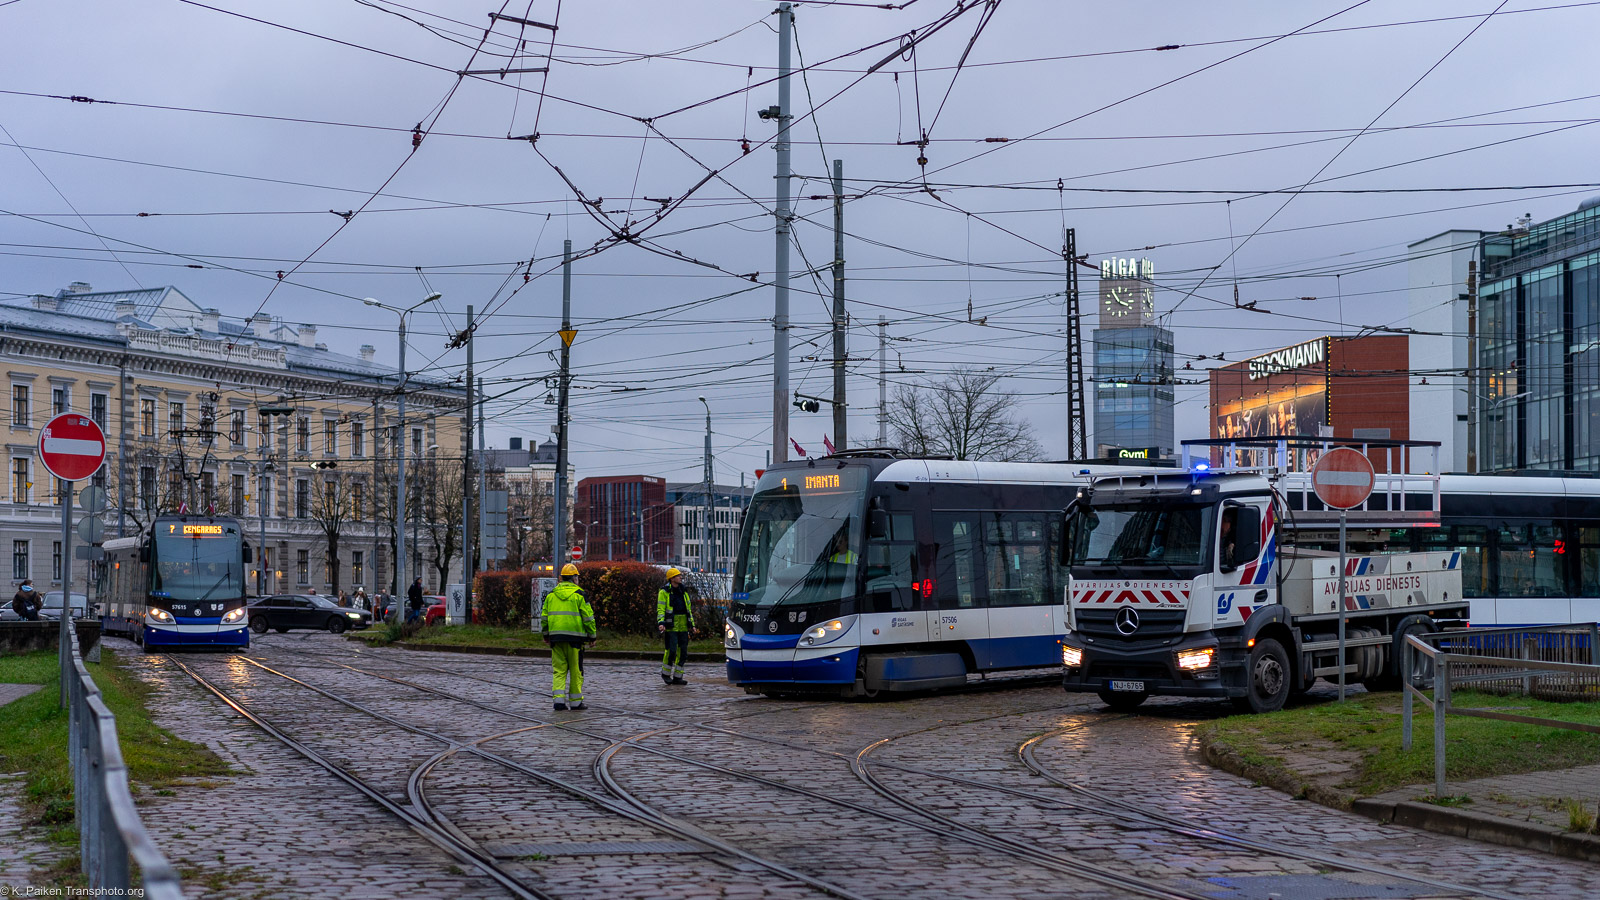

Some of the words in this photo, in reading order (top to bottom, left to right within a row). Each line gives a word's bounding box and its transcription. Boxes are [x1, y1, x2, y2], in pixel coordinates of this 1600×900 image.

[1101, 256, 1137, 279] RĪGA
[1249, 339, 1324, 380] STOCKMANN
[781, 477, 787, 491] 1
[804, 474, 840, 489] IMANTA
[169, 524, 176, 534] 7
[1376, 576, 1421, 591] DIENESTS
[743, 614, 760, 622] 57506
[941, 616, 958, 624] 57506
[1113, 681, 1144, 690] NJ-6765
